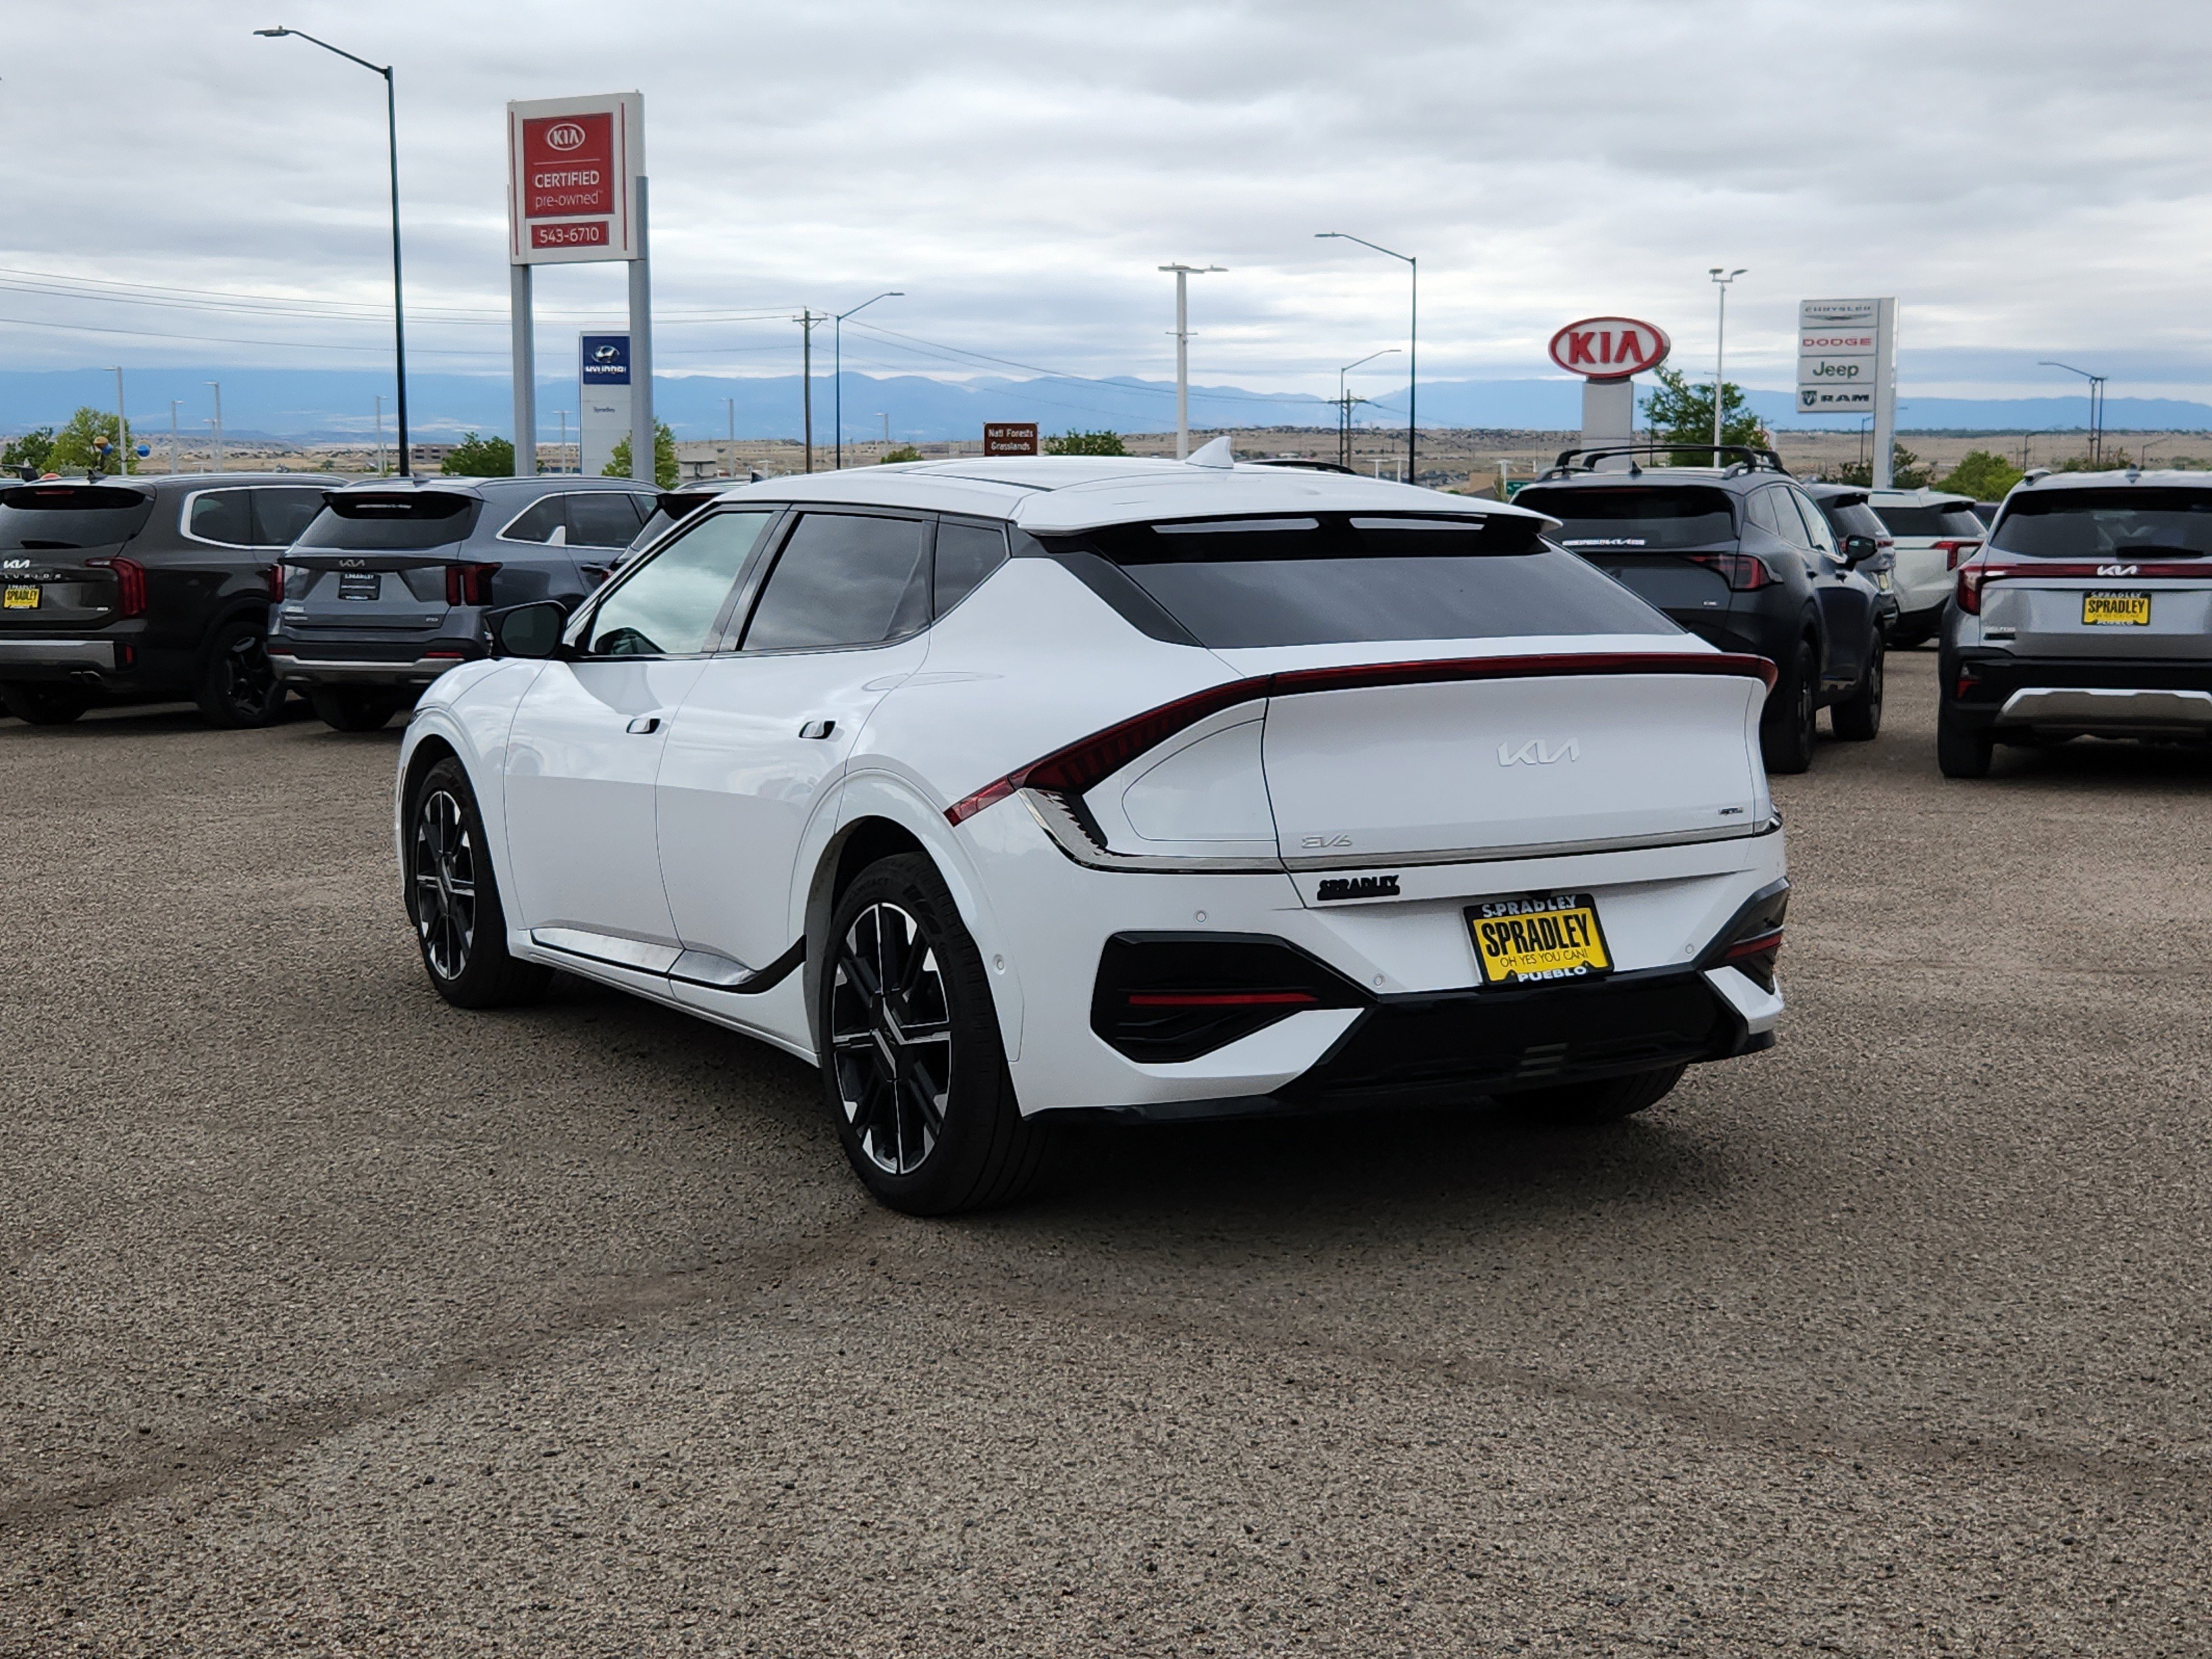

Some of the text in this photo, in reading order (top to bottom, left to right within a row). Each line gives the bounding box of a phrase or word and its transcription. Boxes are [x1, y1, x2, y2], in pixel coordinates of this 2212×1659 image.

[552, 128, 580, 146] KIA
[534, 170, 600, 188] CERTIFIED
[535, 191, 599, 210] pre-owned
[540, 227, 599, 243] 543-6710
[1567, 330, 1644, 364] KIA
[1803, 337, 1871, 347] DODGE
[1812, 361, 1859, 378] Jeep
[1821, 394, 1869, 402] RAM
[991, 441, 1031, 451] Grasslands
[3, 560, 30, 568] KIA
[339, 559, 365, 567] KIA
[2097, 565, 2137, 576] KIA
[7, 591, 37, 600] SPRADLEY
[2088, 600, 2145, 613] SPRADLEY
[1497, 737, 1580, 767] KIA
[1302, 833, 1353, 848] EV6
[1482, 895, 1577, 918] SPRADLEY
[1481, 913, 1591, 957] SPRADLEY
[1500, 956, 1517, 967] OH
[1520, 954, 1536, 965] YES
[1538, 951, 1561, 963] YOU
[1517, 966, 1587, 982] PUEBLO
